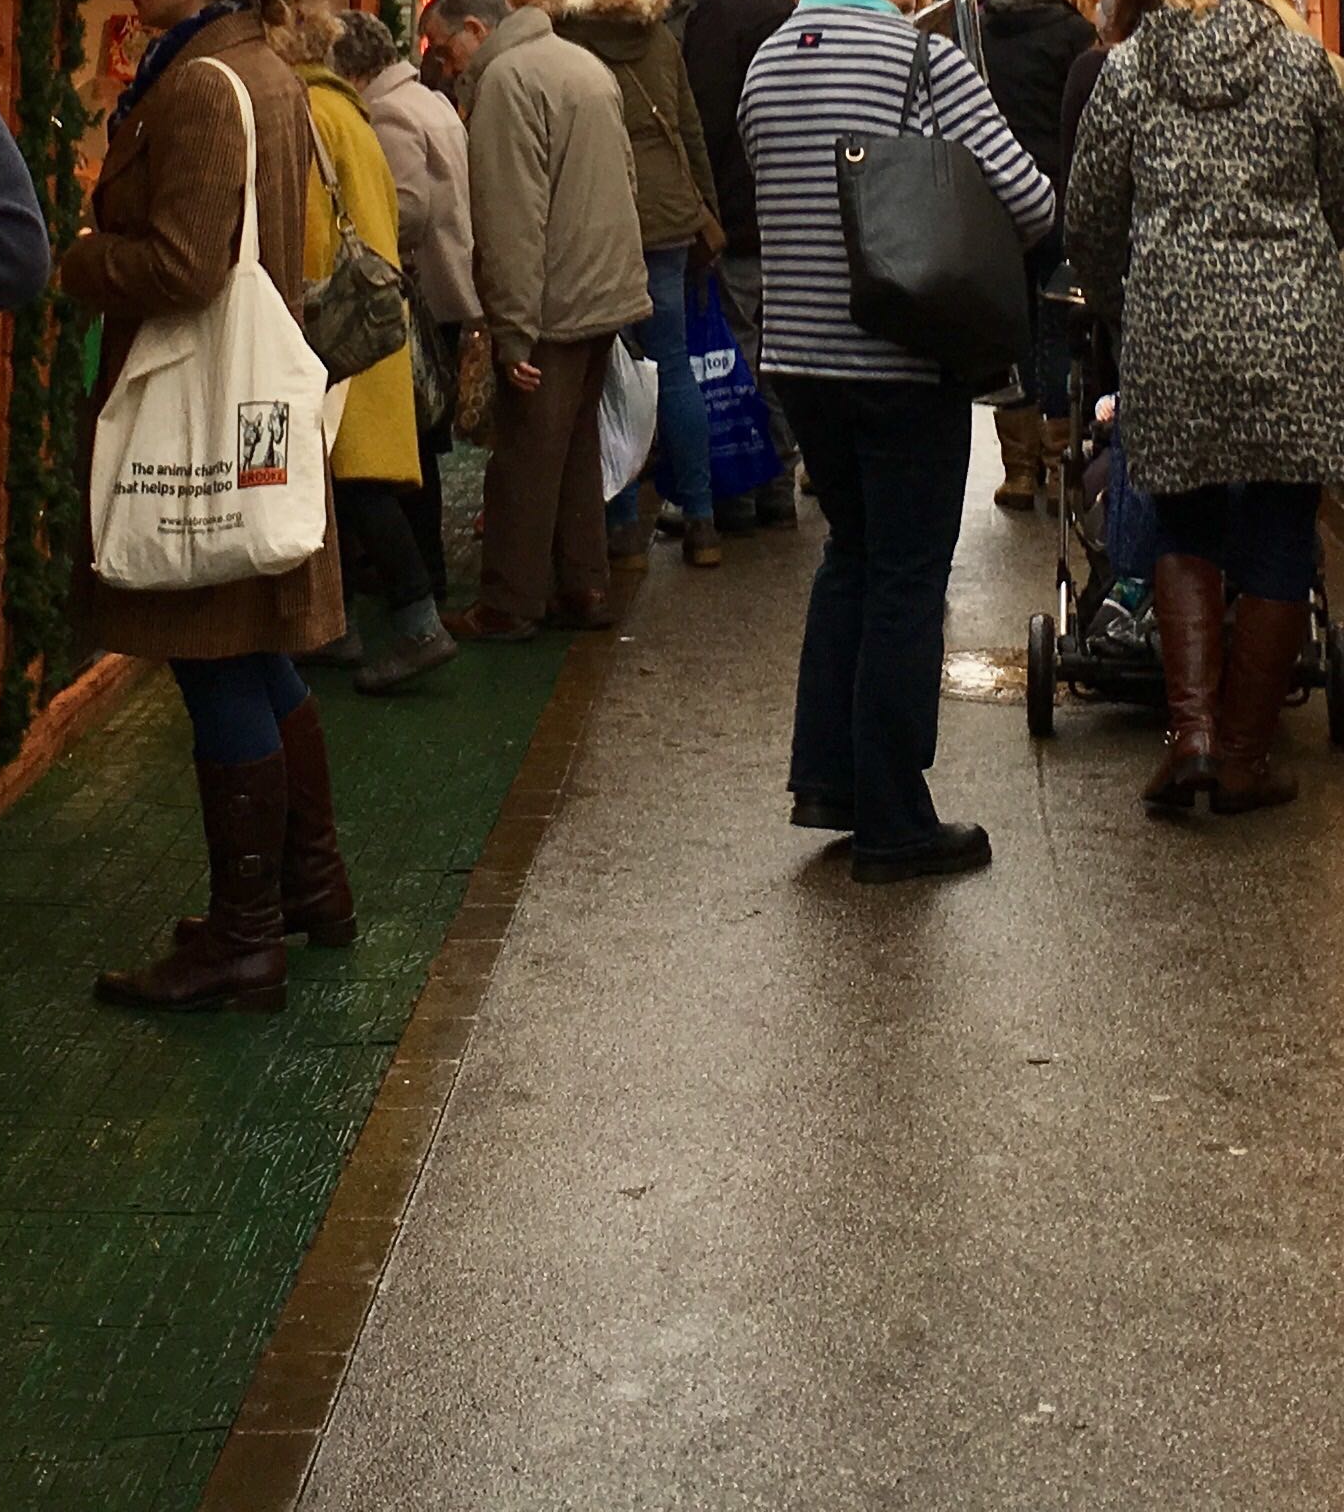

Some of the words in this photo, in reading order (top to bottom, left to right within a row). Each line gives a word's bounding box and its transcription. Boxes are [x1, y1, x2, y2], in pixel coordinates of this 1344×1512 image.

[132, 462, 154, 475] The
[195, 460, 233, 476] charity
[114, 480, 138, 495] that
[141, 480, 175, 496] helps
[213, 480, 233, 493] too
